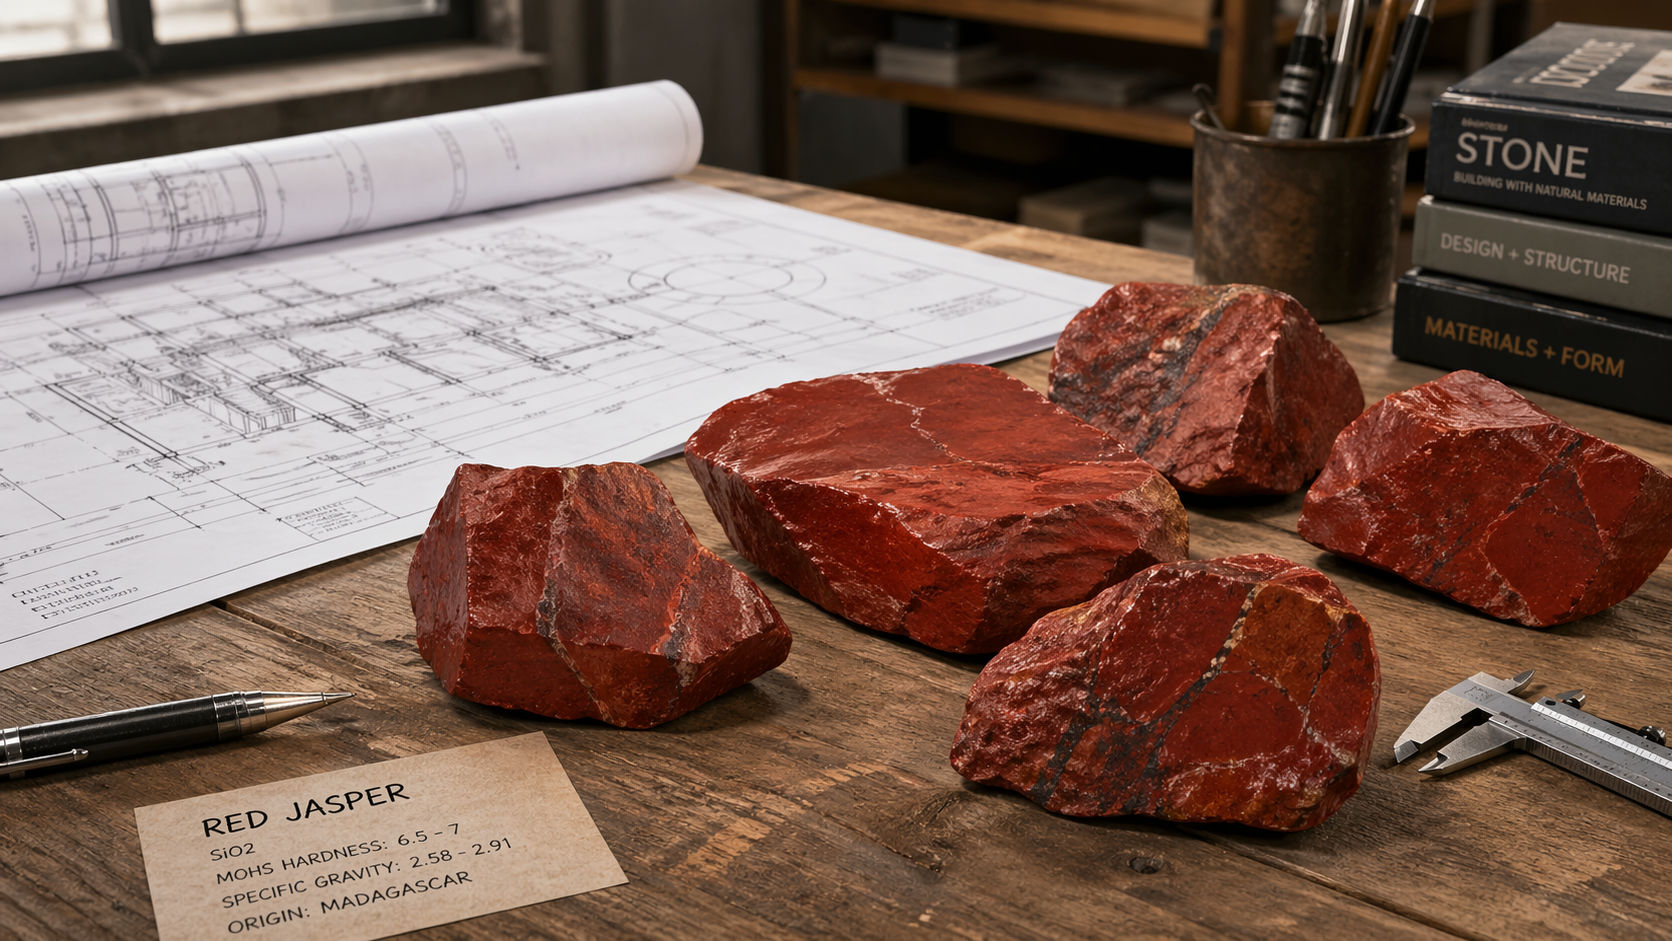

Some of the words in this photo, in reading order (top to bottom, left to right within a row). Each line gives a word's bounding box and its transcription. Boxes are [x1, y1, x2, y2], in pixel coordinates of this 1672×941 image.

[1455, 131, 1589, 180] STONE
[1453, 171, 1503, 189] BUILDING
[1505, 179, 1533, 193] WITH
[1535, 183, 1584, 201] NATURAL
[1586, 191, 1648, 211] MATERIALS
[1440, 232, 1504, 260] DESIGN
[1508, 249, 1520, 261] +
[1523, 248, 1631, 285] STRUCTURE
[1424, 315, 1539, 359] MATERIALS
[1543, 346, 1556, 360] +
[1560, 346, 1625, 379] FORM
[201, 810, 268, 838] RED
[286, 783, 410, 821] JASPER
[210, 842, 255, 861] SiO2
[216, 862, 274, 885] MOHS
[281, 840, 388, 870] HARDNESS:
[398, 830, 428, 846] 6.5
[448, 823, 459, 835] 7
[222, 880, 307, 909] SPECIFIC
[314, 861, 401, 889] GRAVITY:
[409, 850, 453, 868] 2.58
[471, 837, 512, 856] 2.91
[227, 906, 310, 934] ORIGIN:
[320, 871, 473, 914] MADAGASCAR
